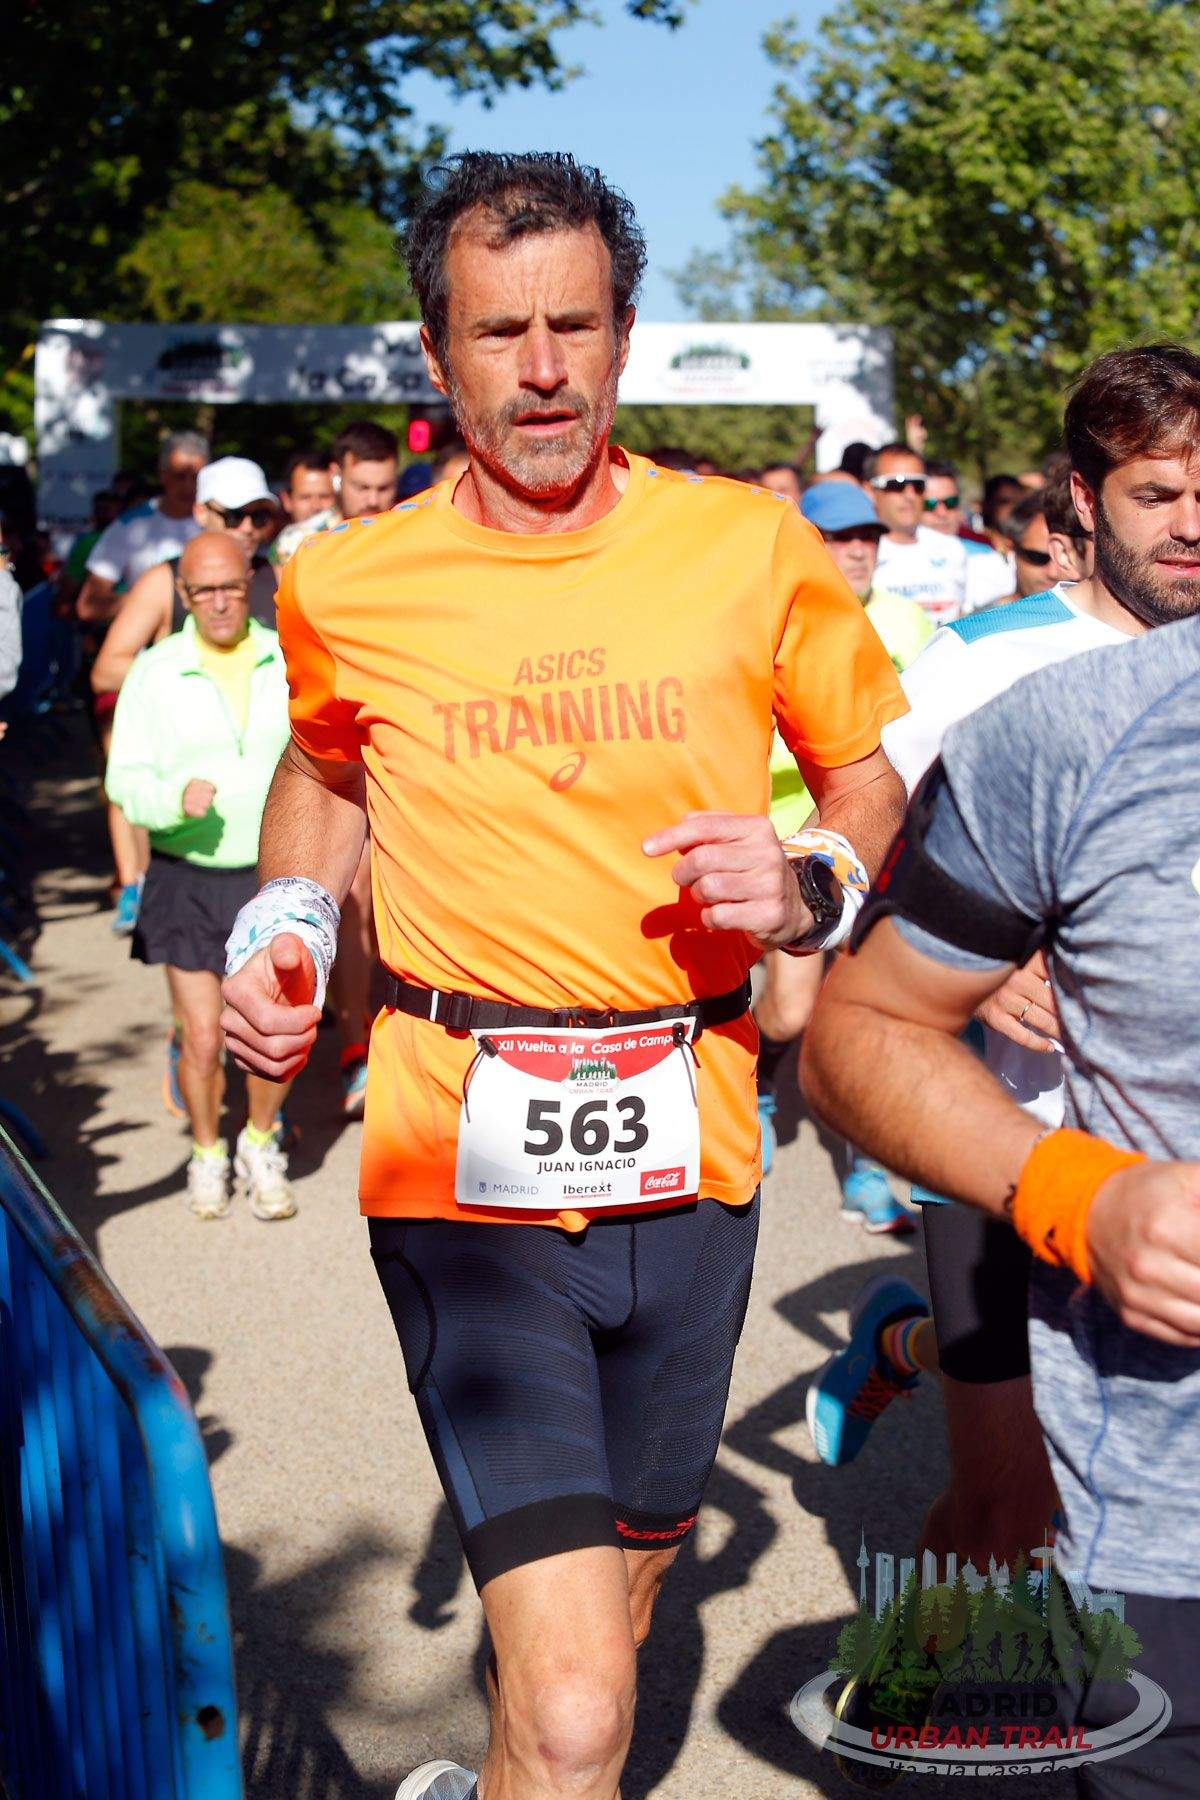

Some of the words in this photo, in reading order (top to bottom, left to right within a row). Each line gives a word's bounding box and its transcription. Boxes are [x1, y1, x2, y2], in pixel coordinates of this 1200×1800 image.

[513, 647, 606, 685] ASICS
[432, 676, 686, 763] TRAINING
[517, 1040, 556, 1053] Vuelta
[558, 1044, 567, 1053] a
[571, 1042, 584, 1054] la
[591, 1042, 622, 1054] Casa
[624, 1038, 637, 1050] de
[524, 1096, 649, 1155] 563
[537, 1161, 575, 1175] JUAN
[579, 1157, 637, 1171] IGNACIO
[493, 1184, 540, 1196] MADRID
[563, 1183, 612, 1194] Iberext
